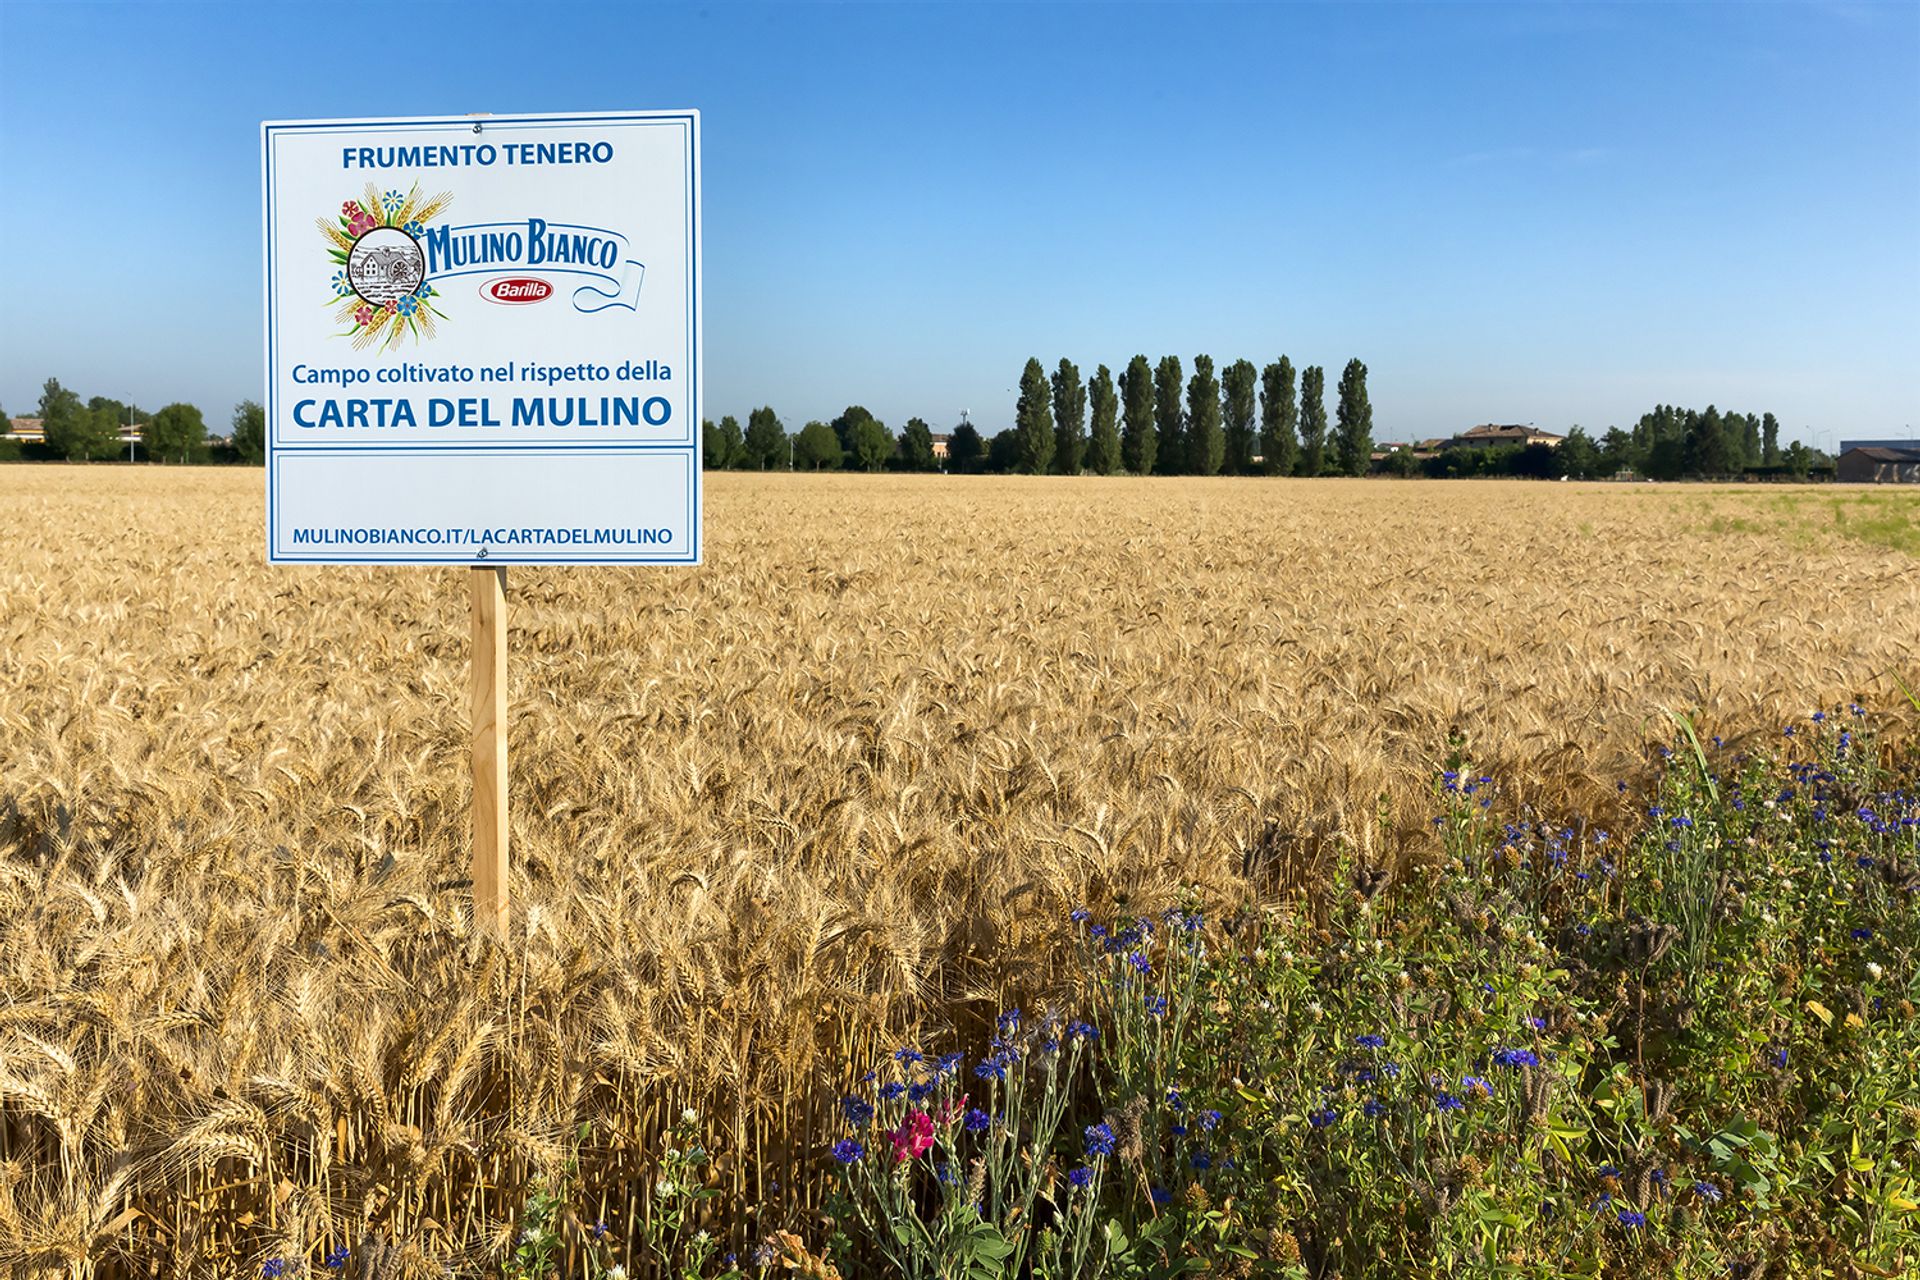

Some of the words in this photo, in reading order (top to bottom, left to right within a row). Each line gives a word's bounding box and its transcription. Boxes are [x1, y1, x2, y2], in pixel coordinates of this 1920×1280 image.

[343, 145, 496, 168] FRUMENTO
[502, 142, 613, 165] TENERO
[496, 282, 548, 299] Barilla
[293, 365, 370, 388] Campo
[377, 363, 474, 383] coltivato
[481, 362, 513, 382] nel
[522, 362, 610, 386] rispetto
[616, 360, 671, 380] della
[293, 399, 417, 428] CARTA
[429, 398, 500, 427] DEL
[512, 397, 671, 426] MULINO
[293, 529, 672, 544] MULINOBIANCO.IT/LACARTADELMULINO
